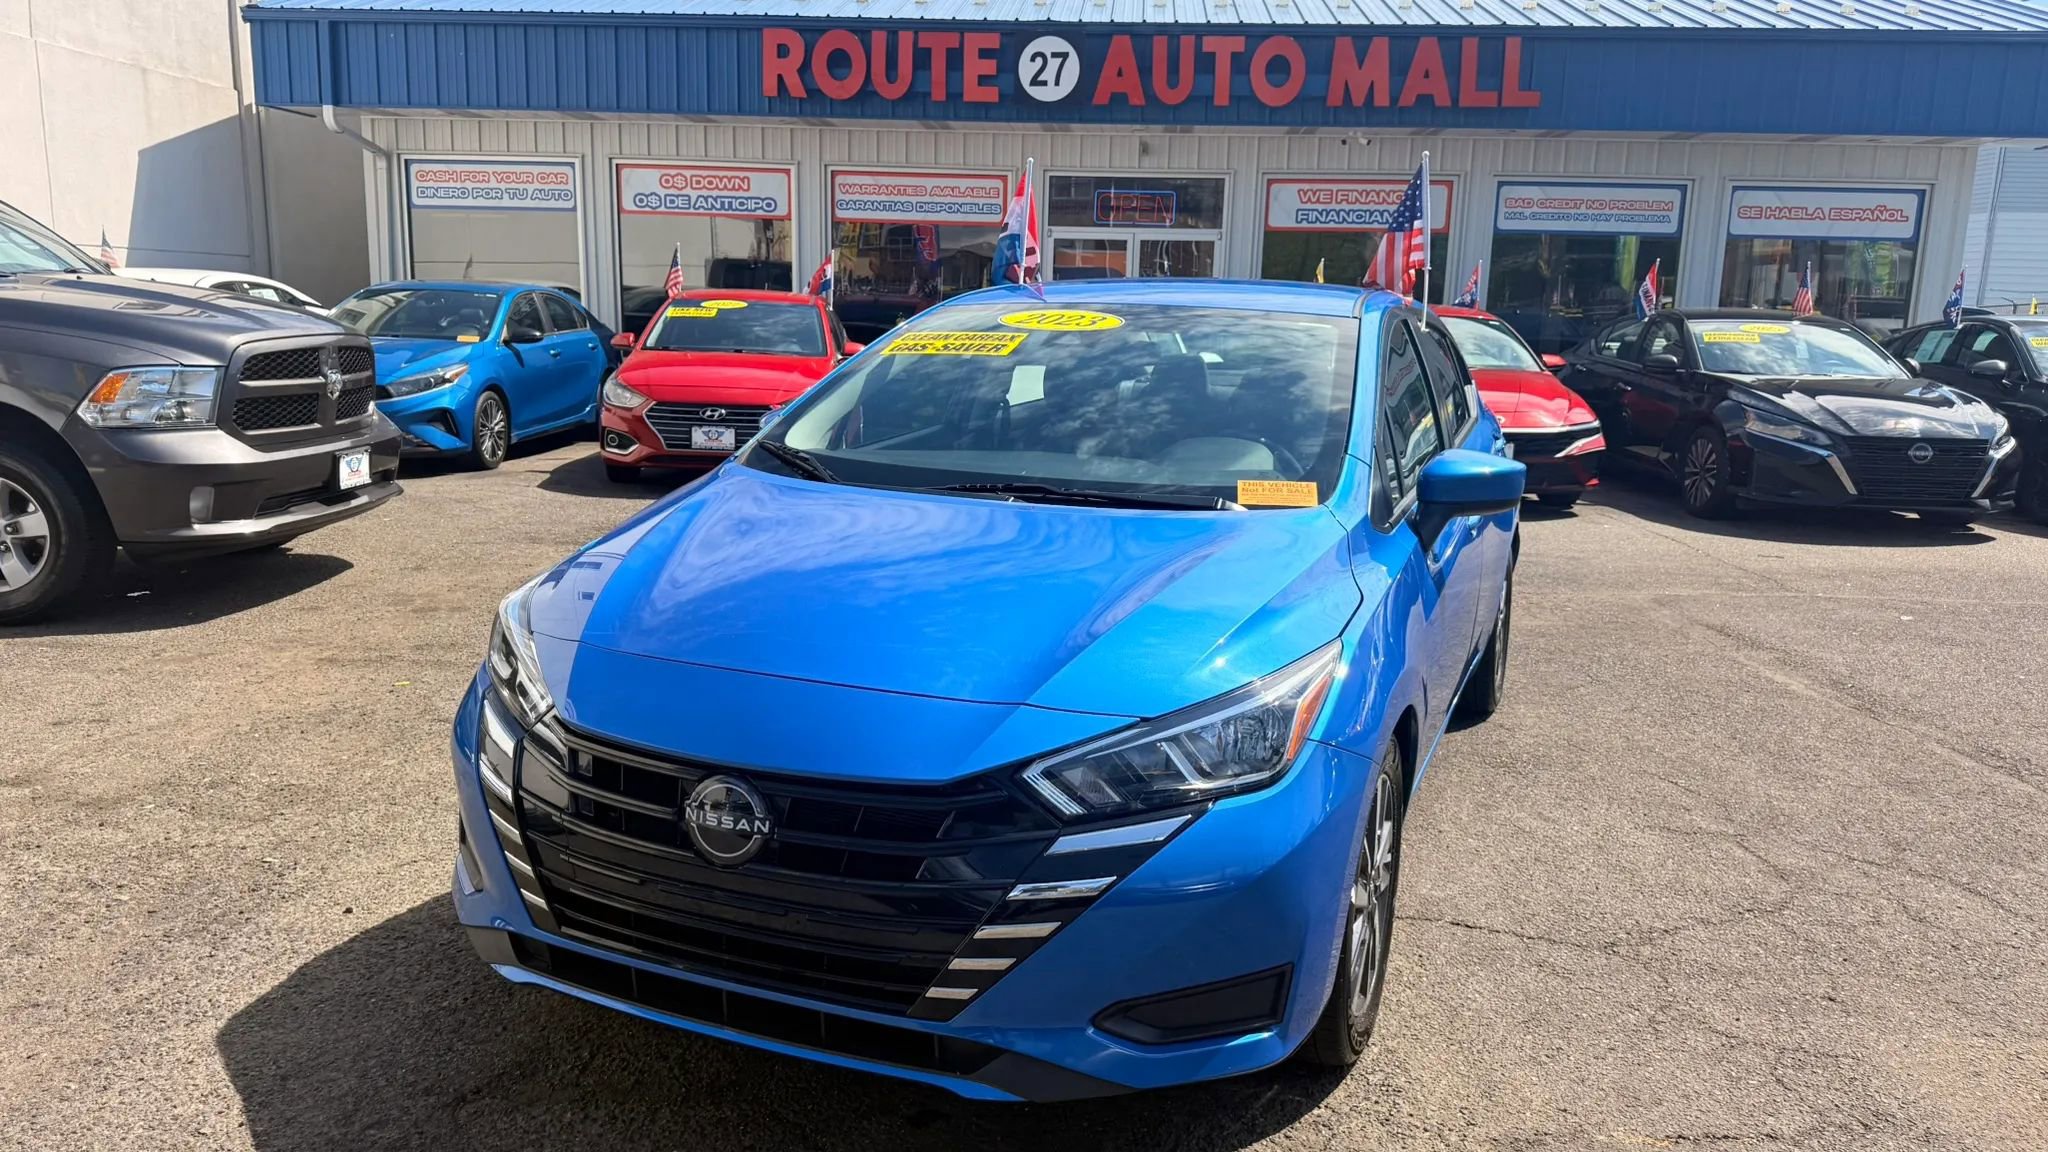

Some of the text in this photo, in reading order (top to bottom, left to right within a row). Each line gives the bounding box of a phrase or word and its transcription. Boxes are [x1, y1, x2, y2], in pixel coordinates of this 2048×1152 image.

[762, 28, 1541, 107] ROUTE 27 AUTO MALL
[416, 170, 568, 185] CASH FOR YOUR CAR
[691, 176, 750, 192] DOWN
[416, 186, 574, 201] DINERO POR TU AUTO
[839, 183, 1000, 198] WARRANTIES AVAILABLE
[1298, 189, 1407, 205] WE FINANC
[665, 196, 691, 210] DE
[693, 196, 777, 213] ANTICIPO
[836, 200, 1001, 215] GARANTIAS DISPONIBLES
[1098, 193, 1173, 224] OPEN
[1504, 198, 1673, 212] BAD CREDIT NO PROBLEM
[1295, 208, 1395, 225] FINANCIAM
[1504, 211, 1671, 224] MAL CREDITO NO HAY PROBLEMA
[1738, 205, 1909, 223] SE HABLA ESPAÑOL
[1019, 312, 1108, 327] 2023
[900, 333, 1018, 343] CLEAN CARFAX
[1286, 487, 1314, 495] SALE
[684, 805, 770, 834] NISSAN
